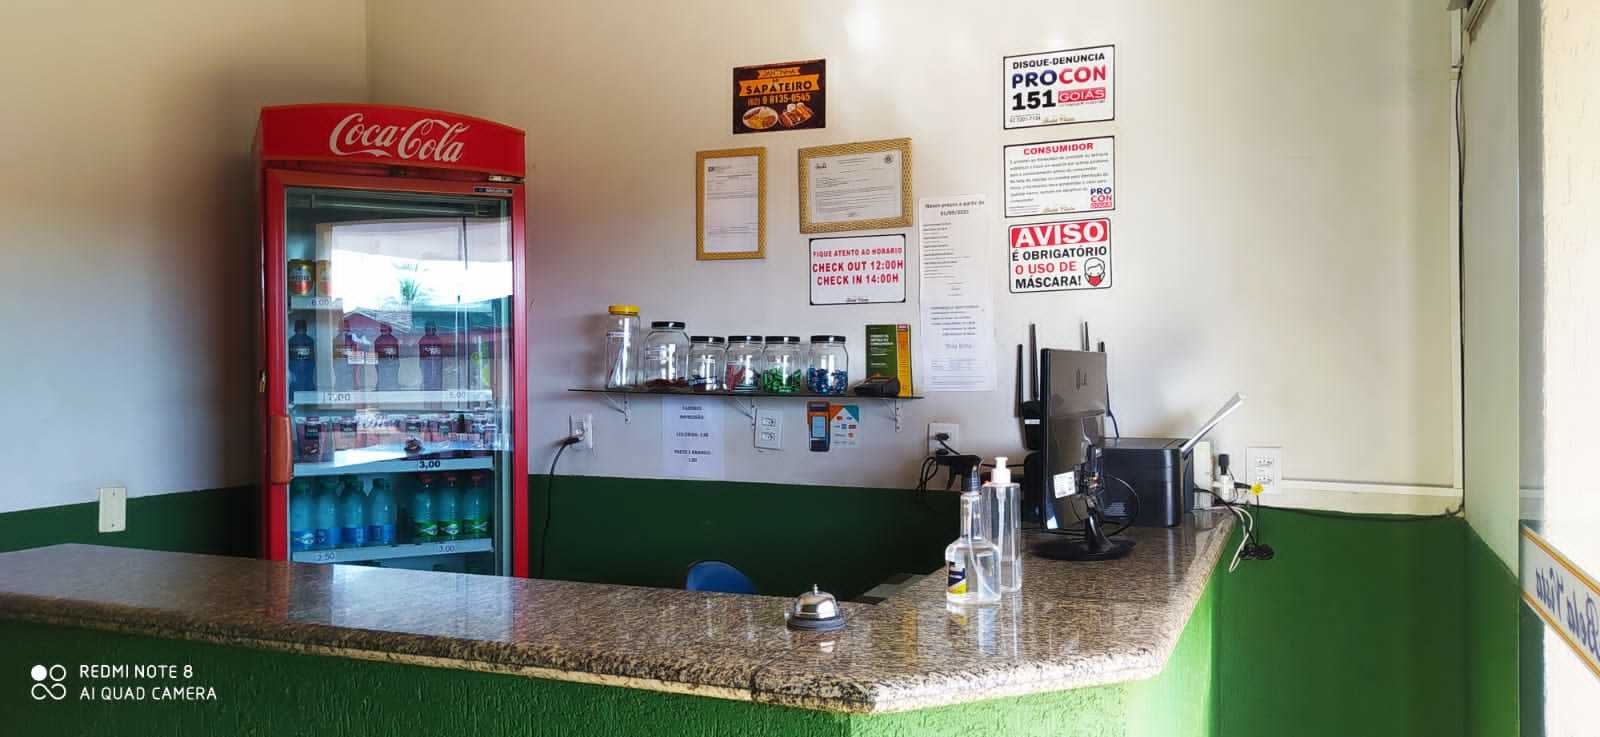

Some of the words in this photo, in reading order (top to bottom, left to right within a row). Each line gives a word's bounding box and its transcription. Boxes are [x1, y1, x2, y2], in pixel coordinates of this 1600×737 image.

[1012, 64, 1106, 89] PROCON
[745, 80, 812, 95] SAPATEIRO
[1011, 88, 1057, 111] 151
[1023, 142, 1094, 156] CONSUMIDOR
[1090, 186, 1112, 195] PRO
[1090, 195, 1112, 203] CON
[1015, 221, 1105, 248] AVISO
[813, 249, 832, 257] FIQUE
[833, 248, 860, 257] ATENTO
[1012, 248, 1020, 261] É
[1022, 244, 1107, 261] OBRIGATÓRIO
[812, 262, 844, 273] CHECK
[847, 261, 867, 272] OUT
[870, 259, 904, 270] 12:00H
[1015, 264, 1024, 275] O
[1028, 262, 1055, 274] USO
[1059, 260, 1078, 272] DE
[817, 275, 849, 286] CHECK
[852, 274, 862, 285] IN
[866, 272, 899, 284] 14:00H
[1015, 274, 1082, 289] MÁSCARA!
[418, 460, 441, 469] 3,00
